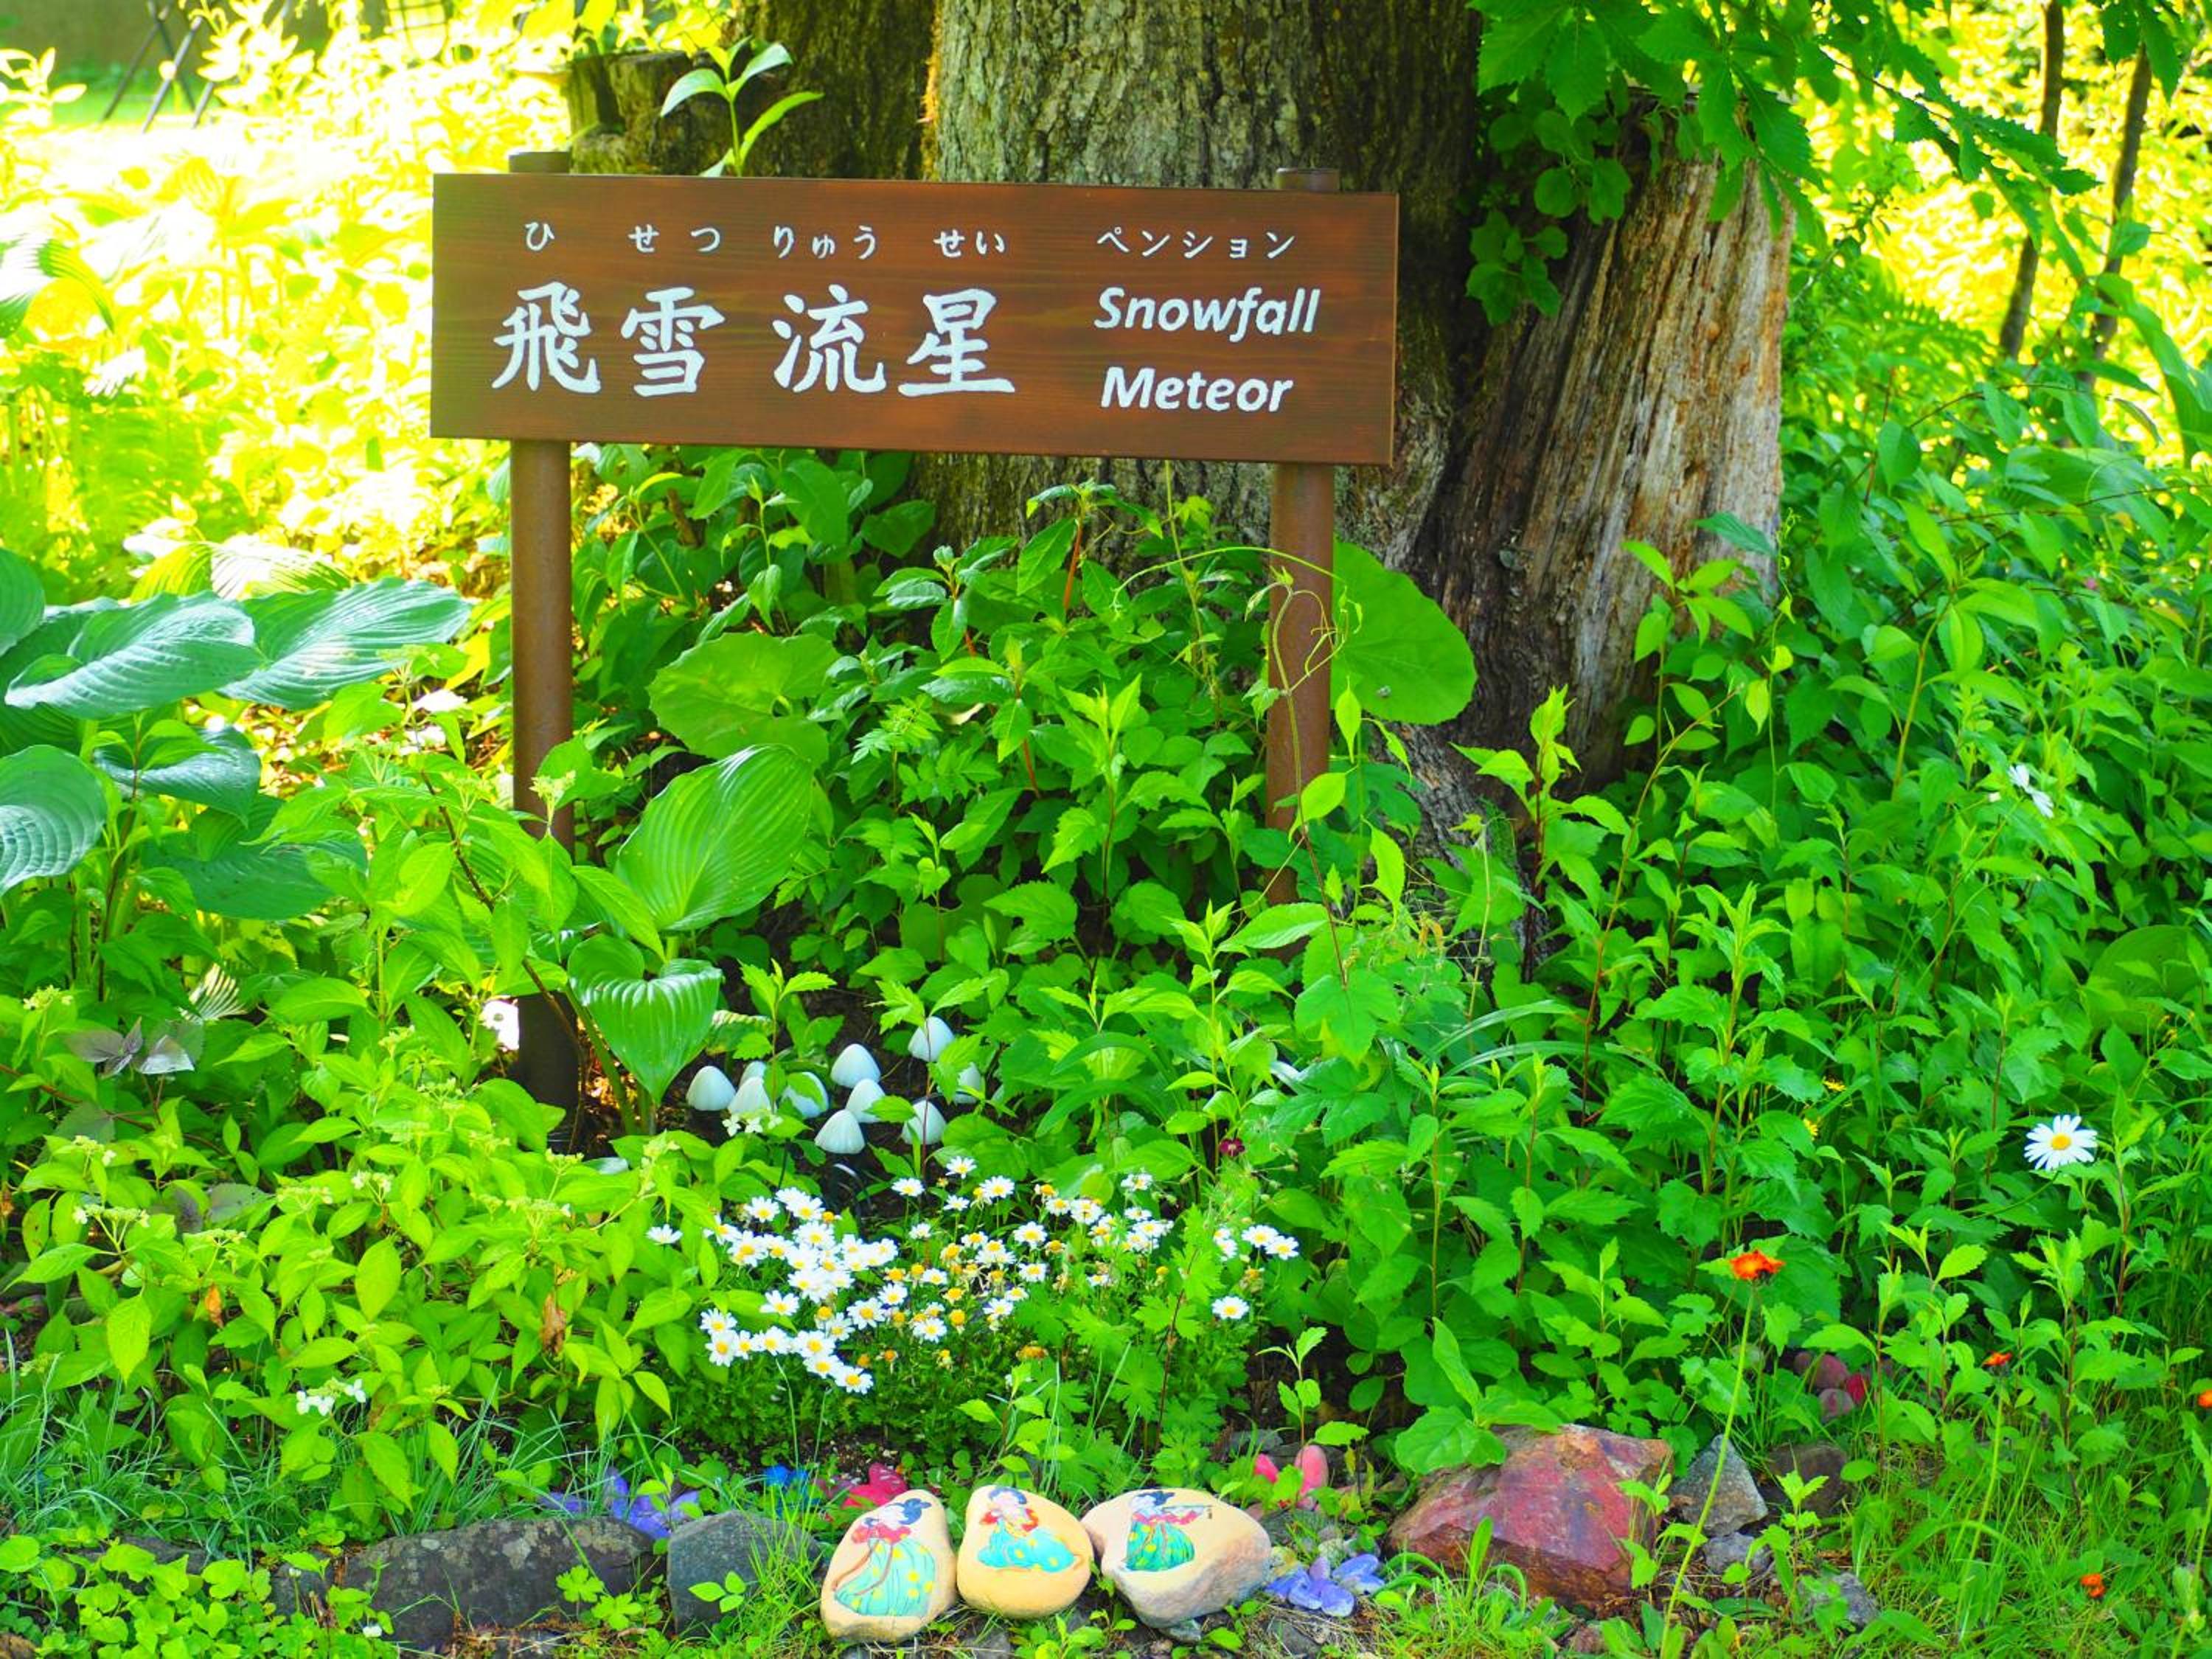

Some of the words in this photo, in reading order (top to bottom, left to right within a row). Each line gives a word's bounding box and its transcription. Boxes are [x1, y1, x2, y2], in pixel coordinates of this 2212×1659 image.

[1096, 226, 1294, 260] ペンション
[1093, 286, 1321, 344] Snowfall
[1100, 366, 1295, 413] Meteor
